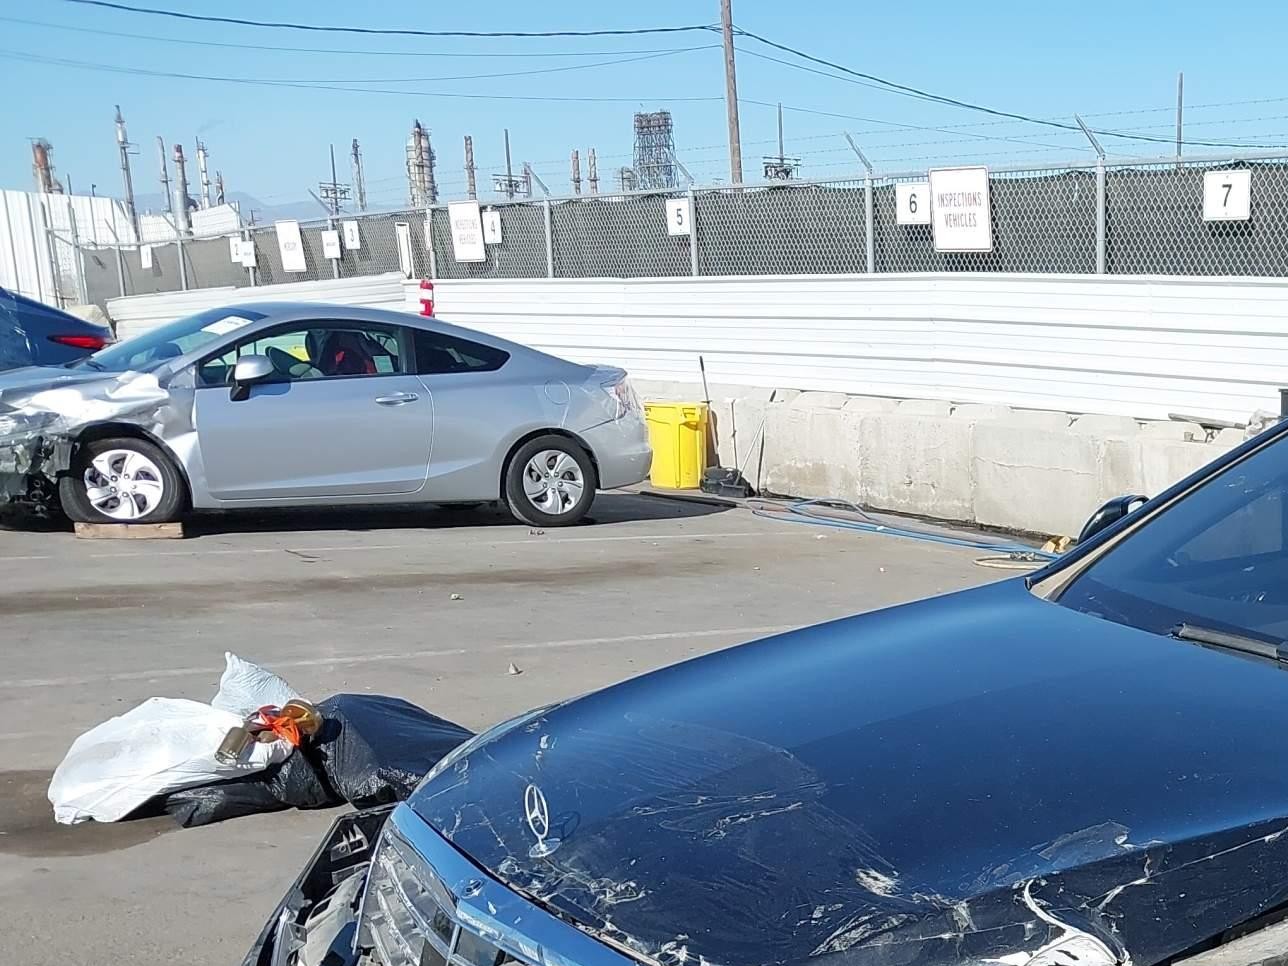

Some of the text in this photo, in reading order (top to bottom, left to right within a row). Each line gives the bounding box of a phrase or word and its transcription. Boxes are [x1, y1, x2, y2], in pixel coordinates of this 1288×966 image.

[909, 193, 917, 213] 6
[937, 191, 982, 208] INSPECTIONS
[1222, 184, 1232, 207] 7
[676, 208, 683, 225] 5
[944, 212, 977, 228] VEHICLES
[490, 220, 496, 236] 4
